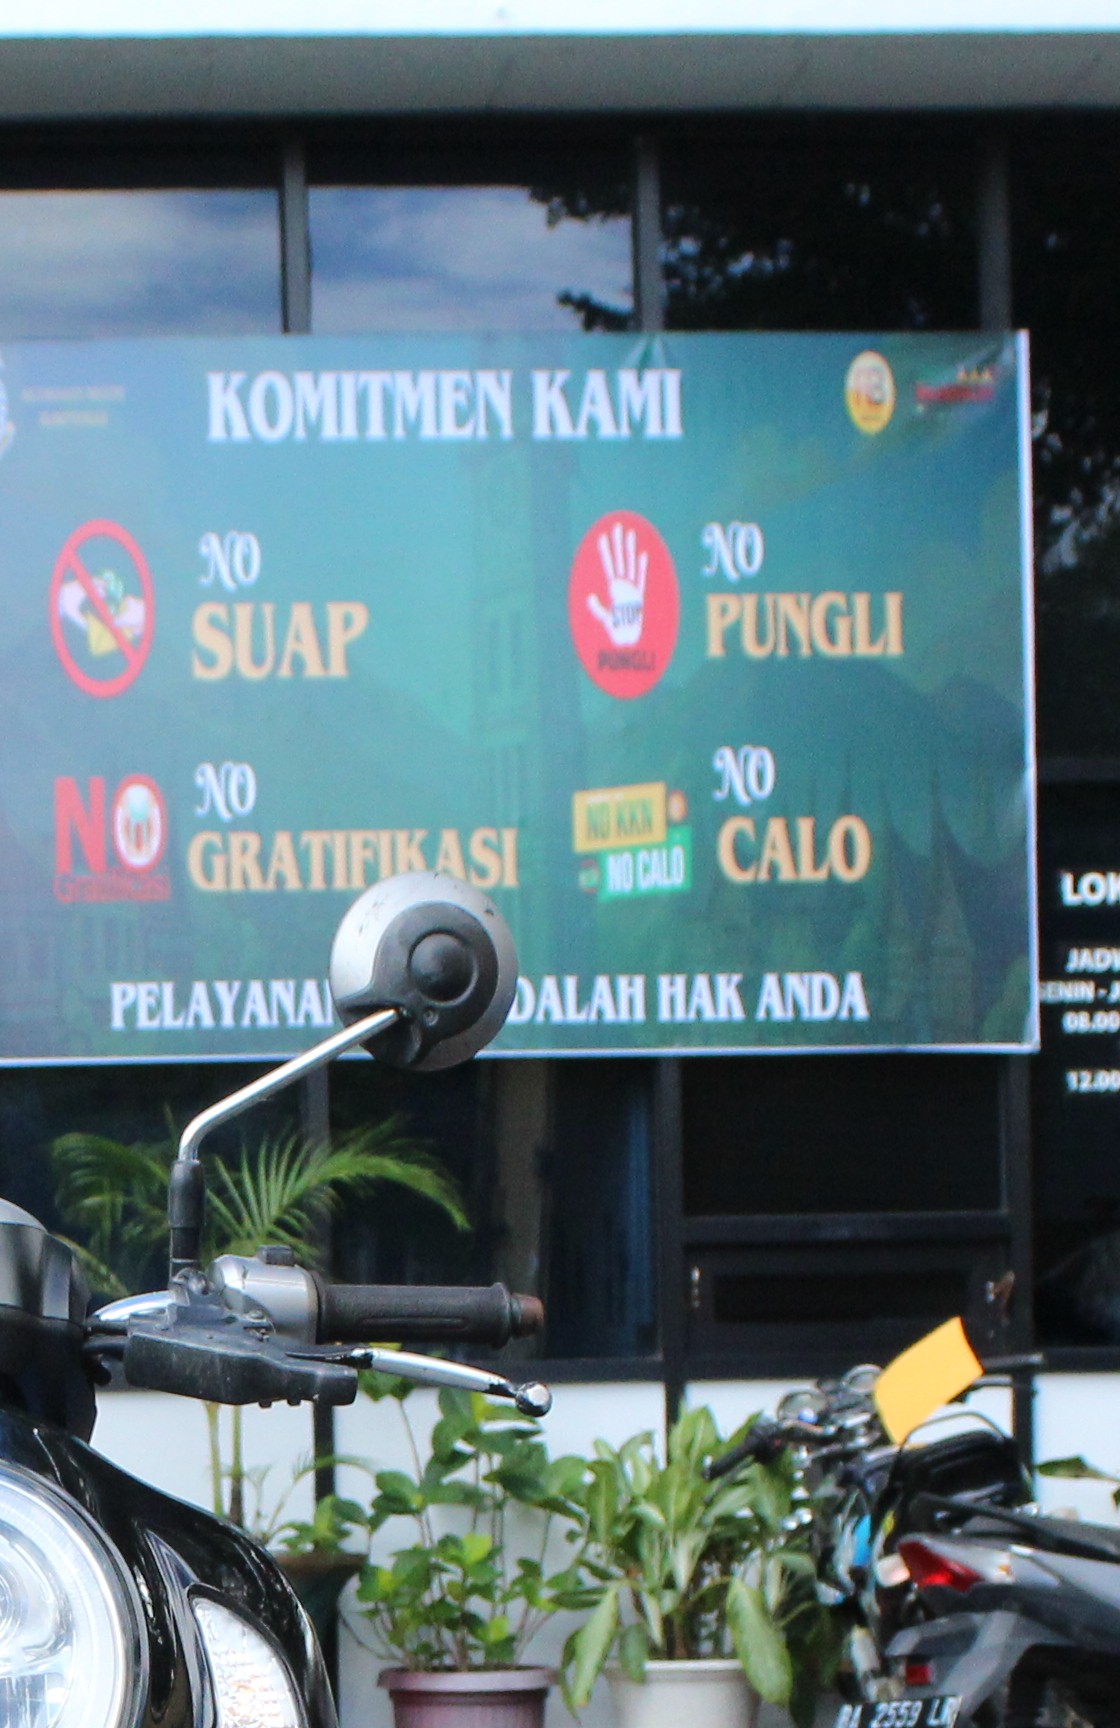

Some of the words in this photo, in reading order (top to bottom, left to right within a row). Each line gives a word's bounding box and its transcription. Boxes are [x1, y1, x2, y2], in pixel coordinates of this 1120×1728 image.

[208, 370, 512, 441] KOMITMEN
[532, 369, 682, 440] KAMI
[199, 530, 261, 590] NO
[703, 520, 765, 581] NO
[192, 602, 369, 680] SUAP
[706, 591, 904, 658] PUNGLI
[194, 762, 256, 821] NO
[713, 746, 775, 805] NO
[188, 828, 519, 891] GRATIFIKASI
[717, 815, 872, 883] CALO
[506, 974, 647, 1025] DALAH
[657, 973, 746, 1022] HAK
[756, 971, 870, 1021] ANDA
